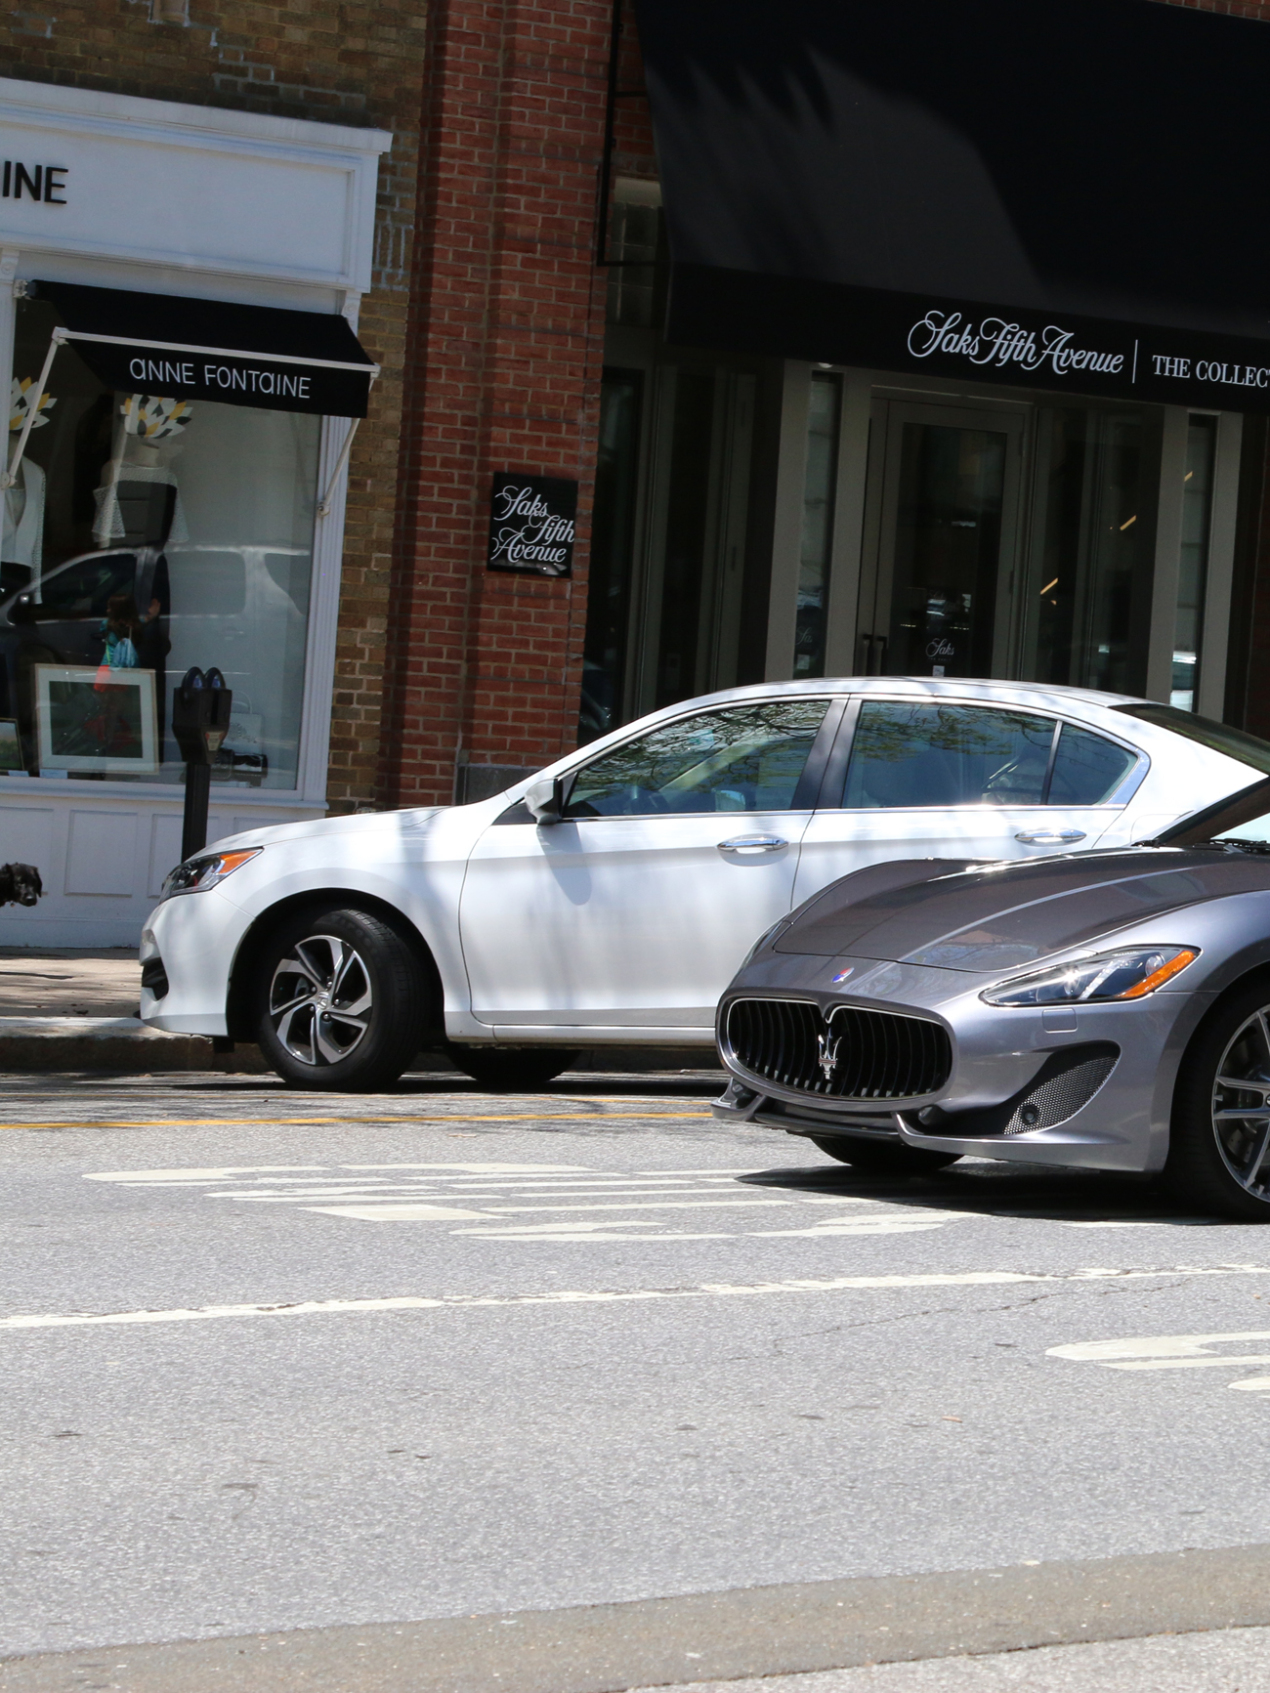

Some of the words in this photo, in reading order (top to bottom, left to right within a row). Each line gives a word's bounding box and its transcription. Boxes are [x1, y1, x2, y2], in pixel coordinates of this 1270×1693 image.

[907, 310, 980, 358] Saks
[969, 317, 1037, 366] Fifth
[1022, 325, 1125, 375] Avenue
[1152, 354, 1191, 379] THE
[494, 485, 549, 521] Saks
[490, 526, 568, 563] Avenue
[520, 512, 576, 546] Fifth
